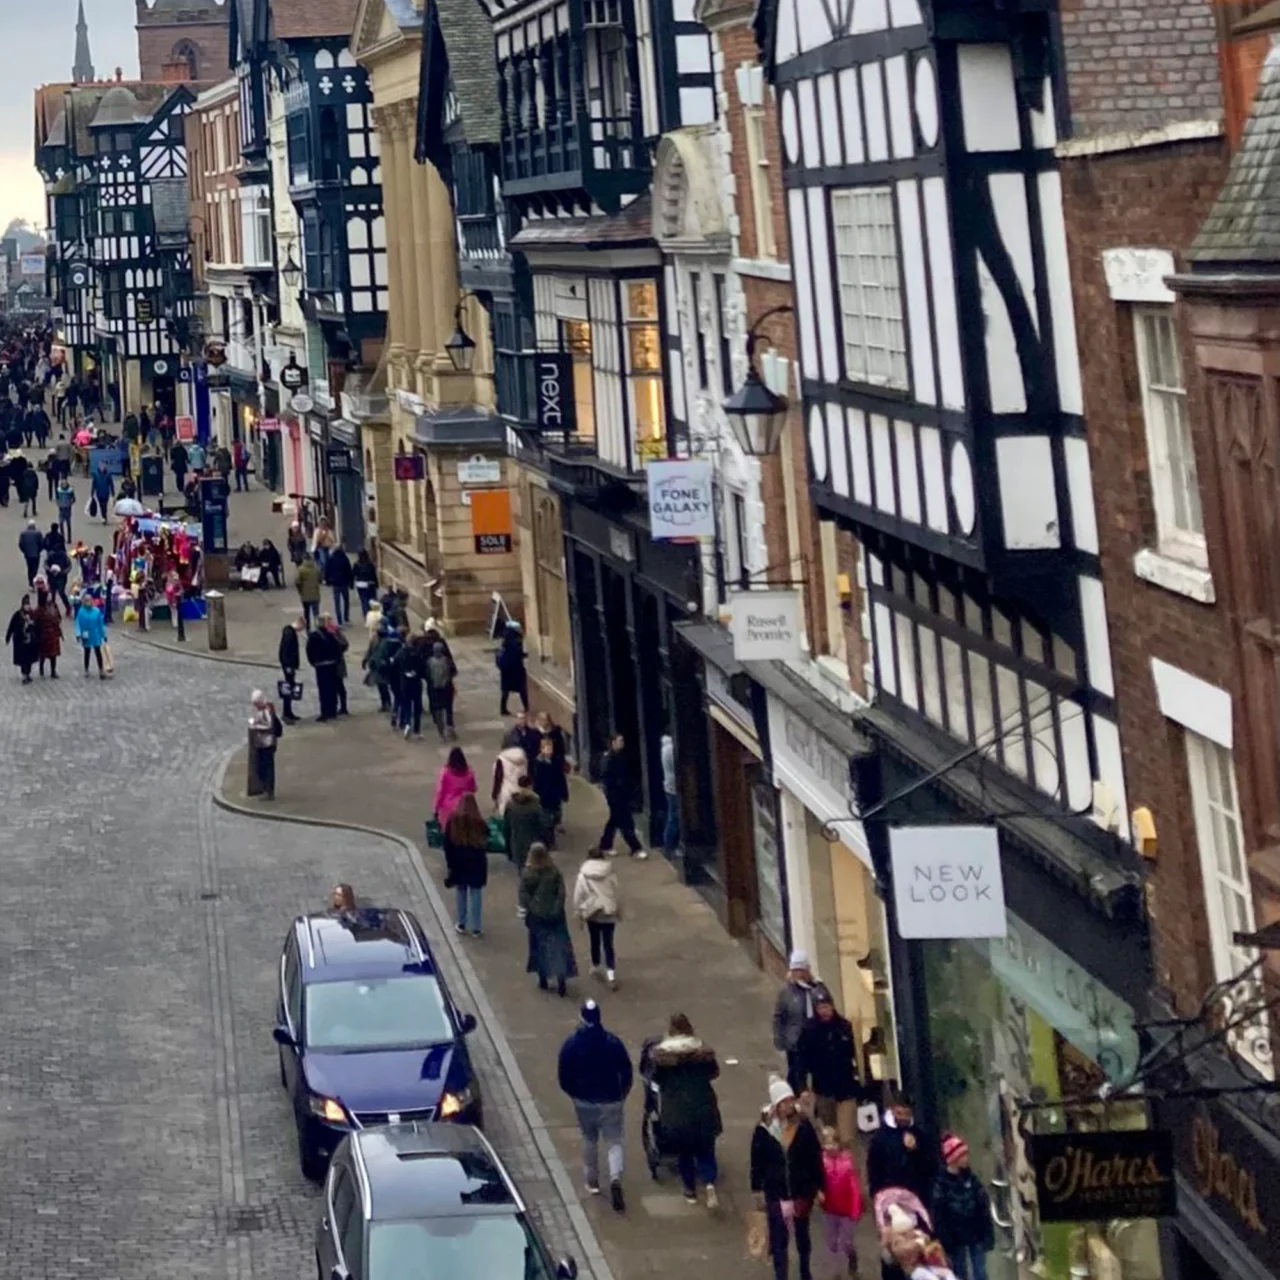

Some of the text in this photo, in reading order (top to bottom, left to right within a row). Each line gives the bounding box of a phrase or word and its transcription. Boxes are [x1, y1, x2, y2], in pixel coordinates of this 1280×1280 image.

[540, 362, 562, 425] next
[661, 488, 701, 500] FONE
[653, 501, 709, 513] GALAXY
[914, 864, 983, 882] NEW
[910, 884, 992, 903] LOOK
